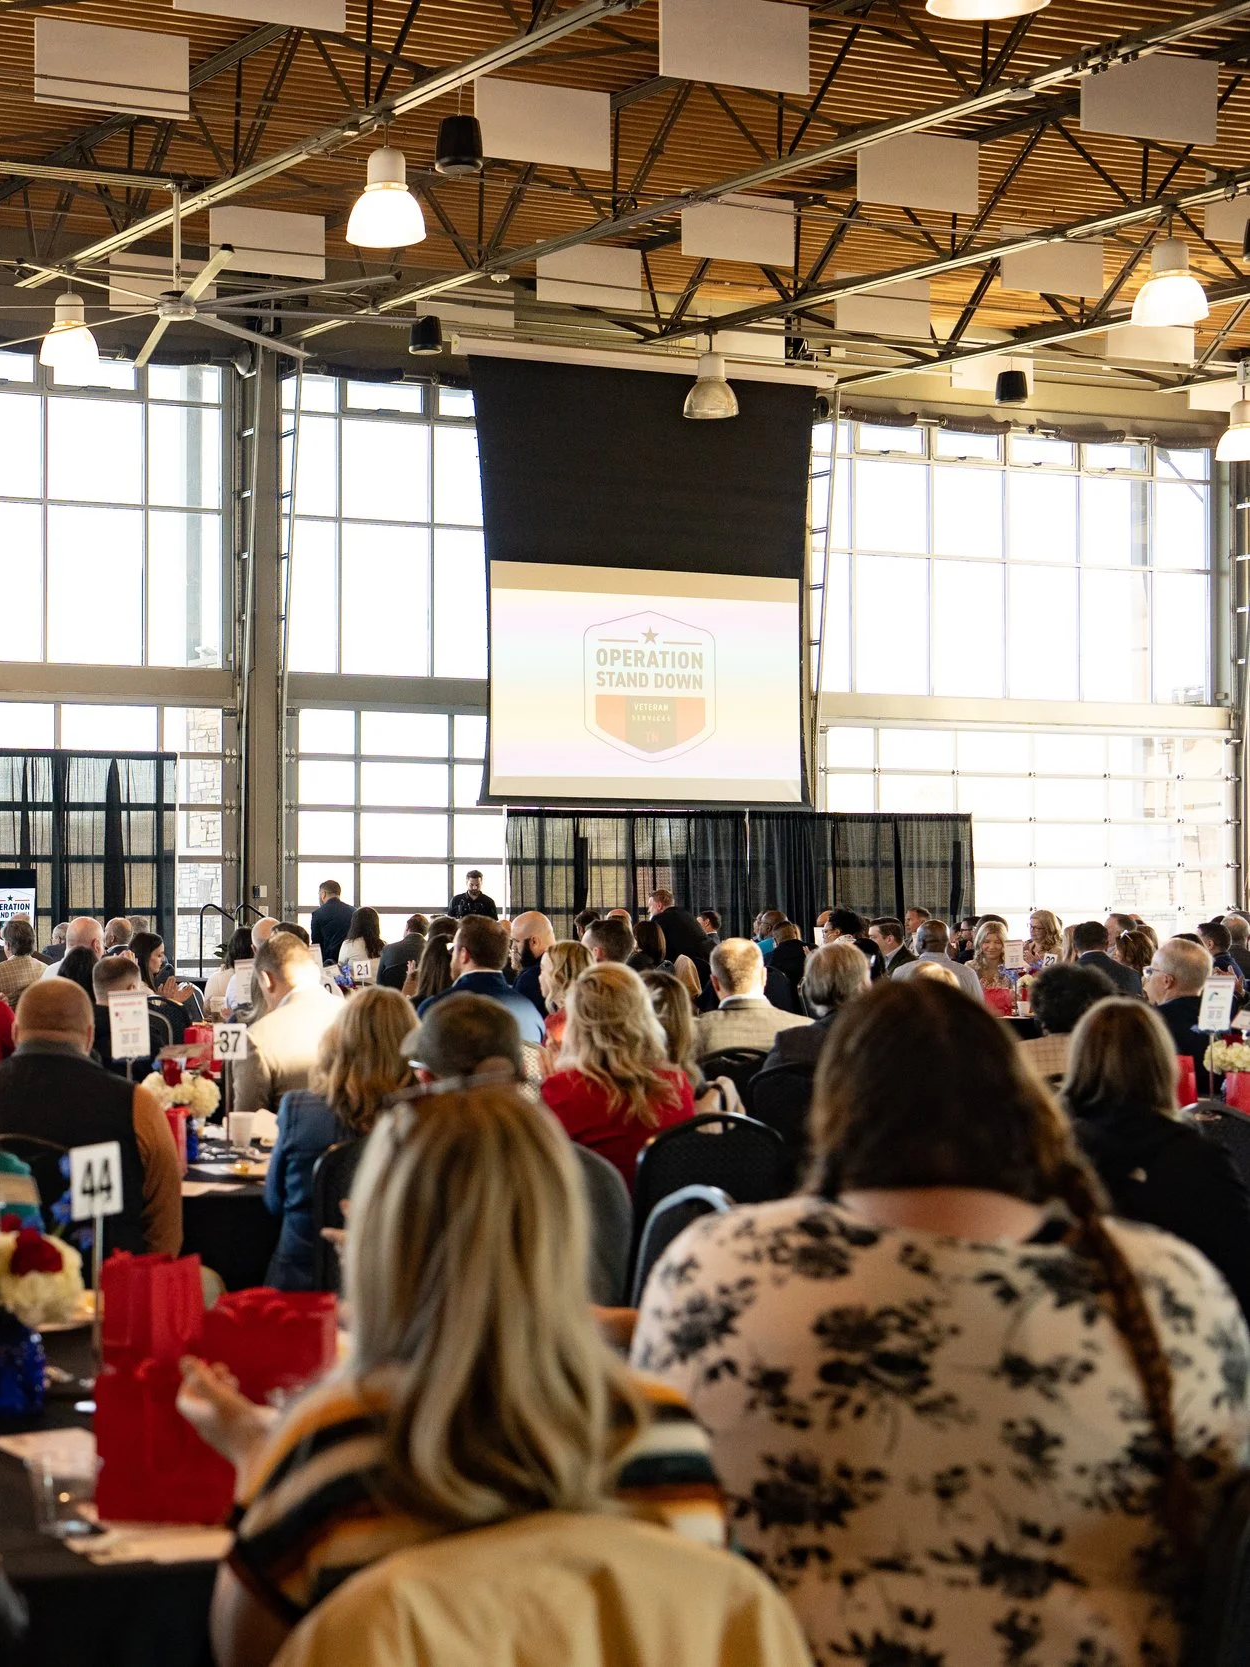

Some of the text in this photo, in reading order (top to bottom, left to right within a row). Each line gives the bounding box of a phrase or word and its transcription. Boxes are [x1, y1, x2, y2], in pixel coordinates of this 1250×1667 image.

[595, 648, 703, 670] OPERATION
[596, 671, 703, 690] STAND DOWN
[634, 703, 669, 711] VETERAN
[357, 964, 369, 976] 21
[219, 1031, 241, 1053] 37
[81, 1158, 113, 1202] 44
